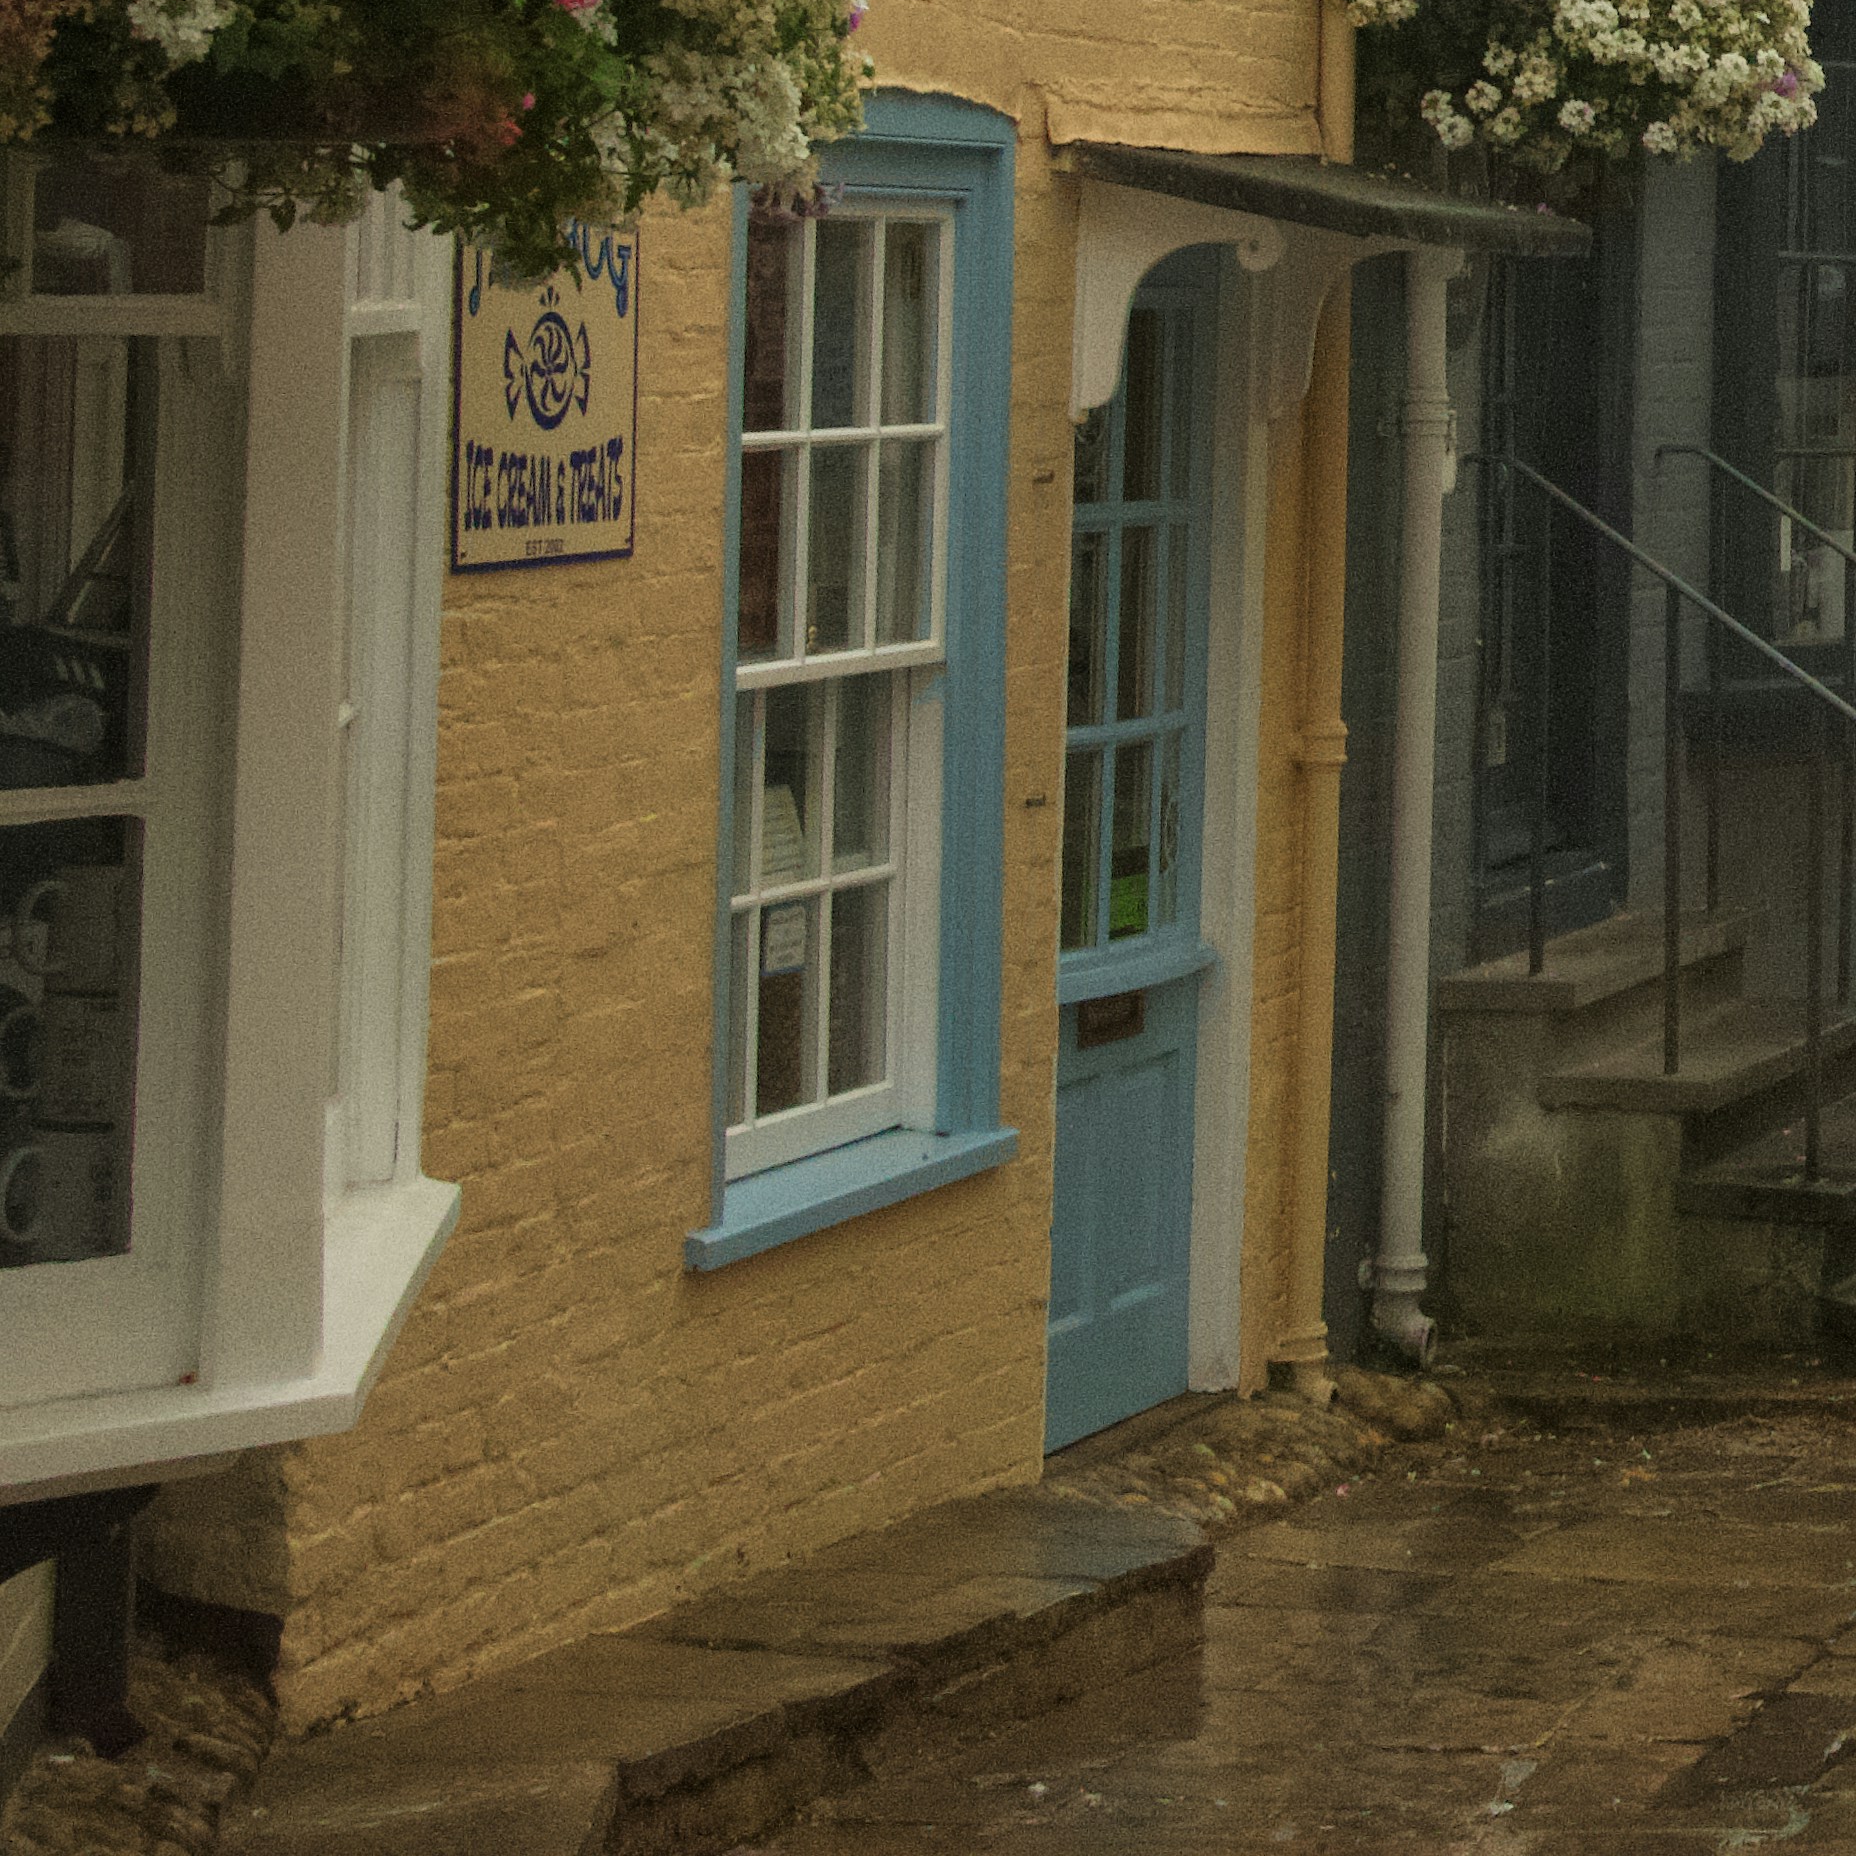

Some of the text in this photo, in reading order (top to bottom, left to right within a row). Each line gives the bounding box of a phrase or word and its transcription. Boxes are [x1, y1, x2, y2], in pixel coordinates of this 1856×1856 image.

[464, 435, 624, 532] ICE CREAM & TREATS
